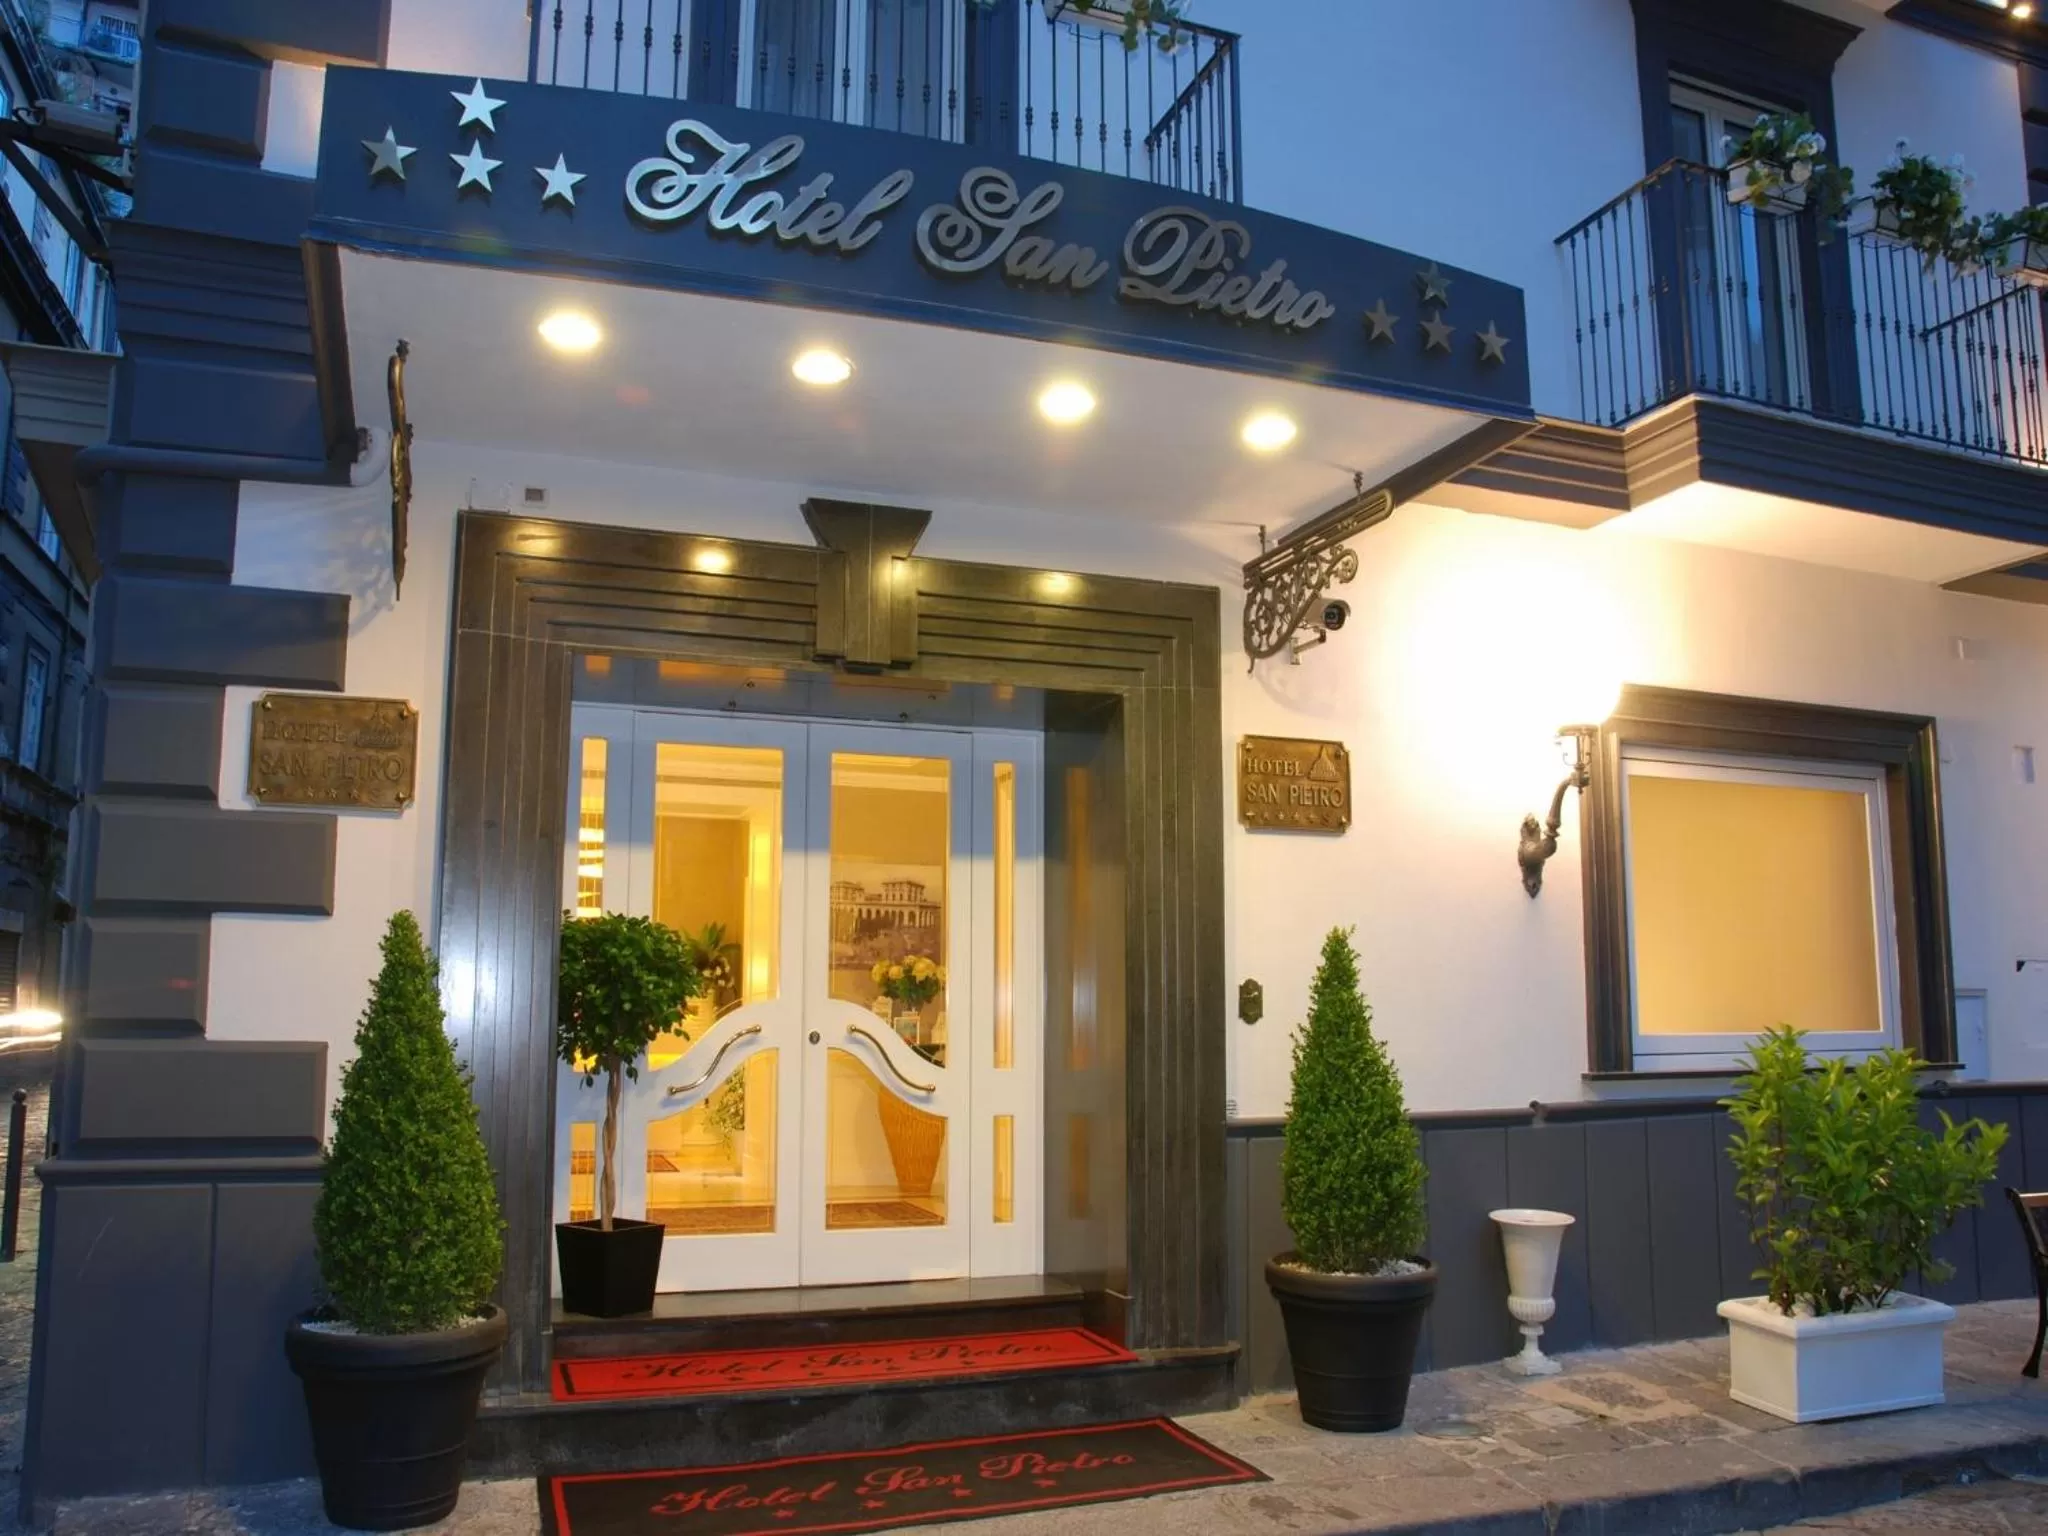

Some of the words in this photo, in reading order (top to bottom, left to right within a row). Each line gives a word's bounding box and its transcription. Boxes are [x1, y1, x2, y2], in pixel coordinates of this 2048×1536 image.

[624, 118, 914, 252] Hotel
[915, 166, 1110, 290] San
[1119, 206, 1335, 330] Pietro
[262, 720, 347, 743] HOTEL
[259, 751, 309, 777] SAN
[321, 753, 405, 781] PIETRO
[1246, 758, 1304, 777] HOTEL
[1246, 783, 1279, 804] SAN
[1289, 784, 1343, 808] PIETRO
[623, 1358, 784, 1380] Hotel
[801, 1349, 893, 1369] San
[908, 1343, 1053, 1362] Pietro
[649, 1482, 837, 1515] Hotel
[855, 1465, 964, 1496] San
[980, 1452, 1137, 1480] Pietro
